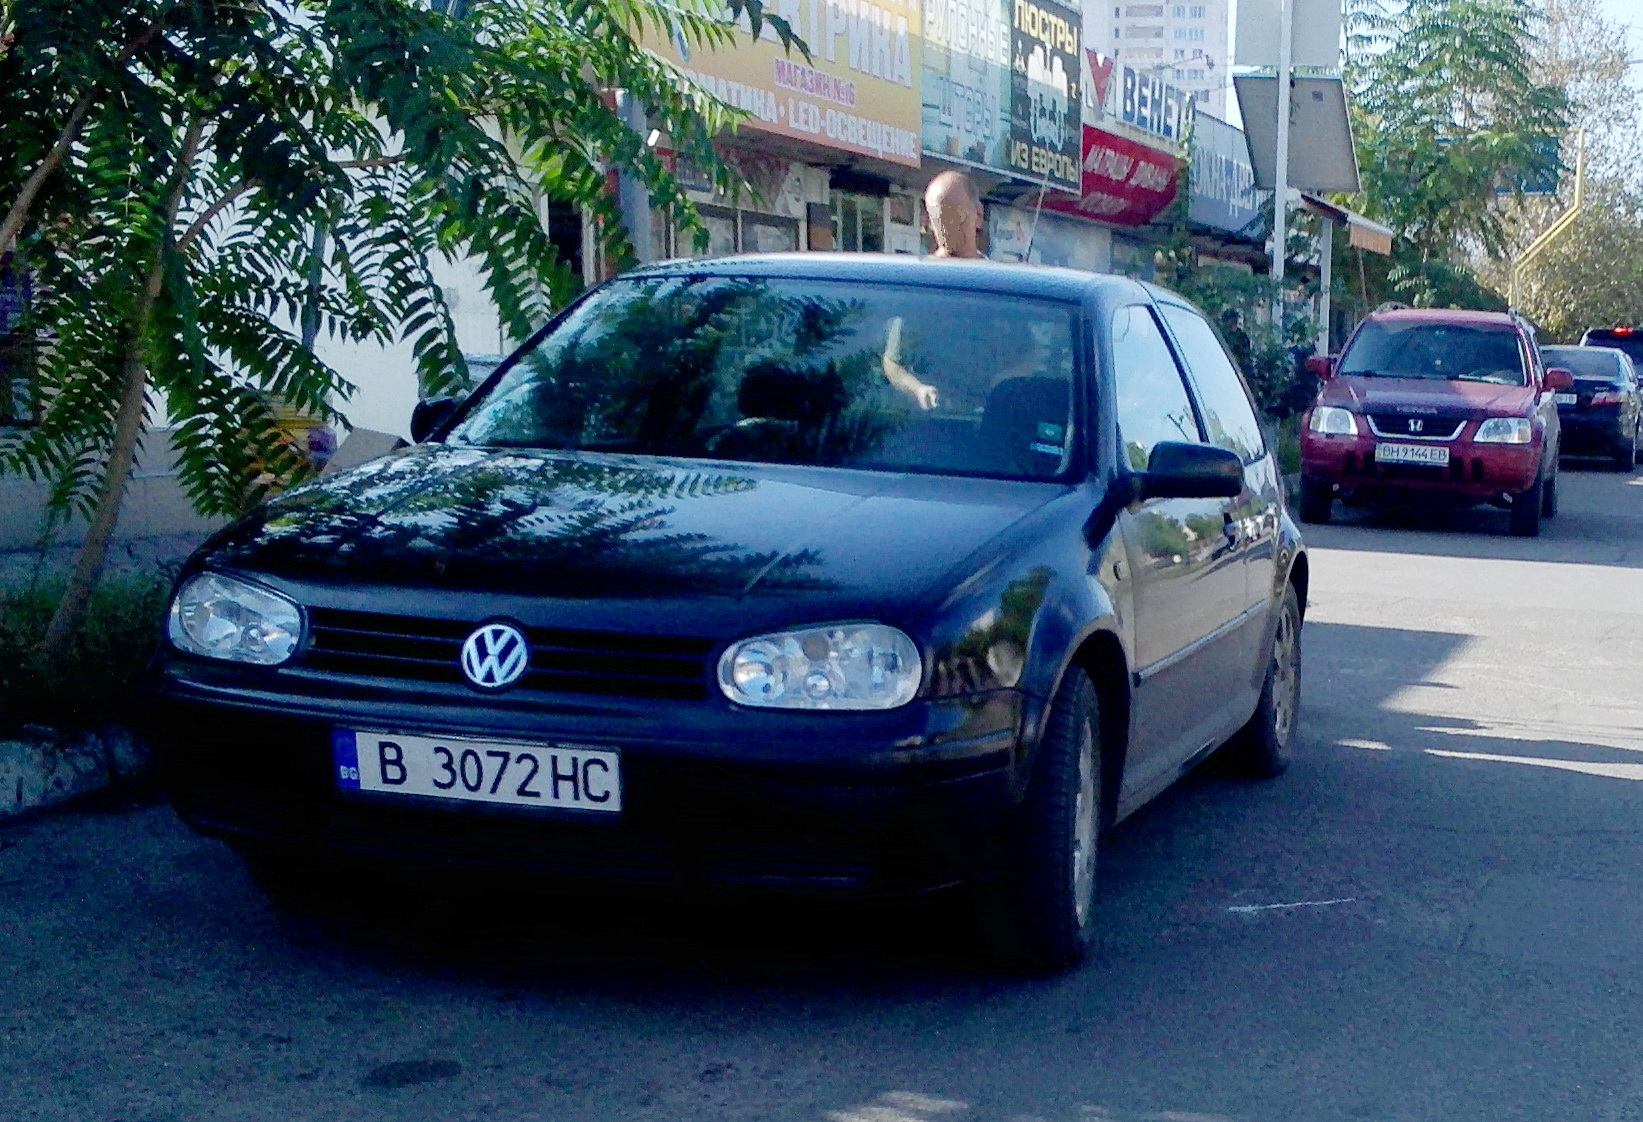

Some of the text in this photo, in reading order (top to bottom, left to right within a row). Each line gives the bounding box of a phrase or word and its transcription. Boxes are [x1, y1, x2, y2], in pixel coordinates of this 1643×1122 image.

[1013, 0, 1078, 56] ЛЮСТРЫ
[774, 58, 831, 98] МАГАЗИН
[1011, 140, 1029, 170] ИЗ
[1031, 147, 1079, 184] ЕВРОПЫ
[379, 741, 407, 785] B
